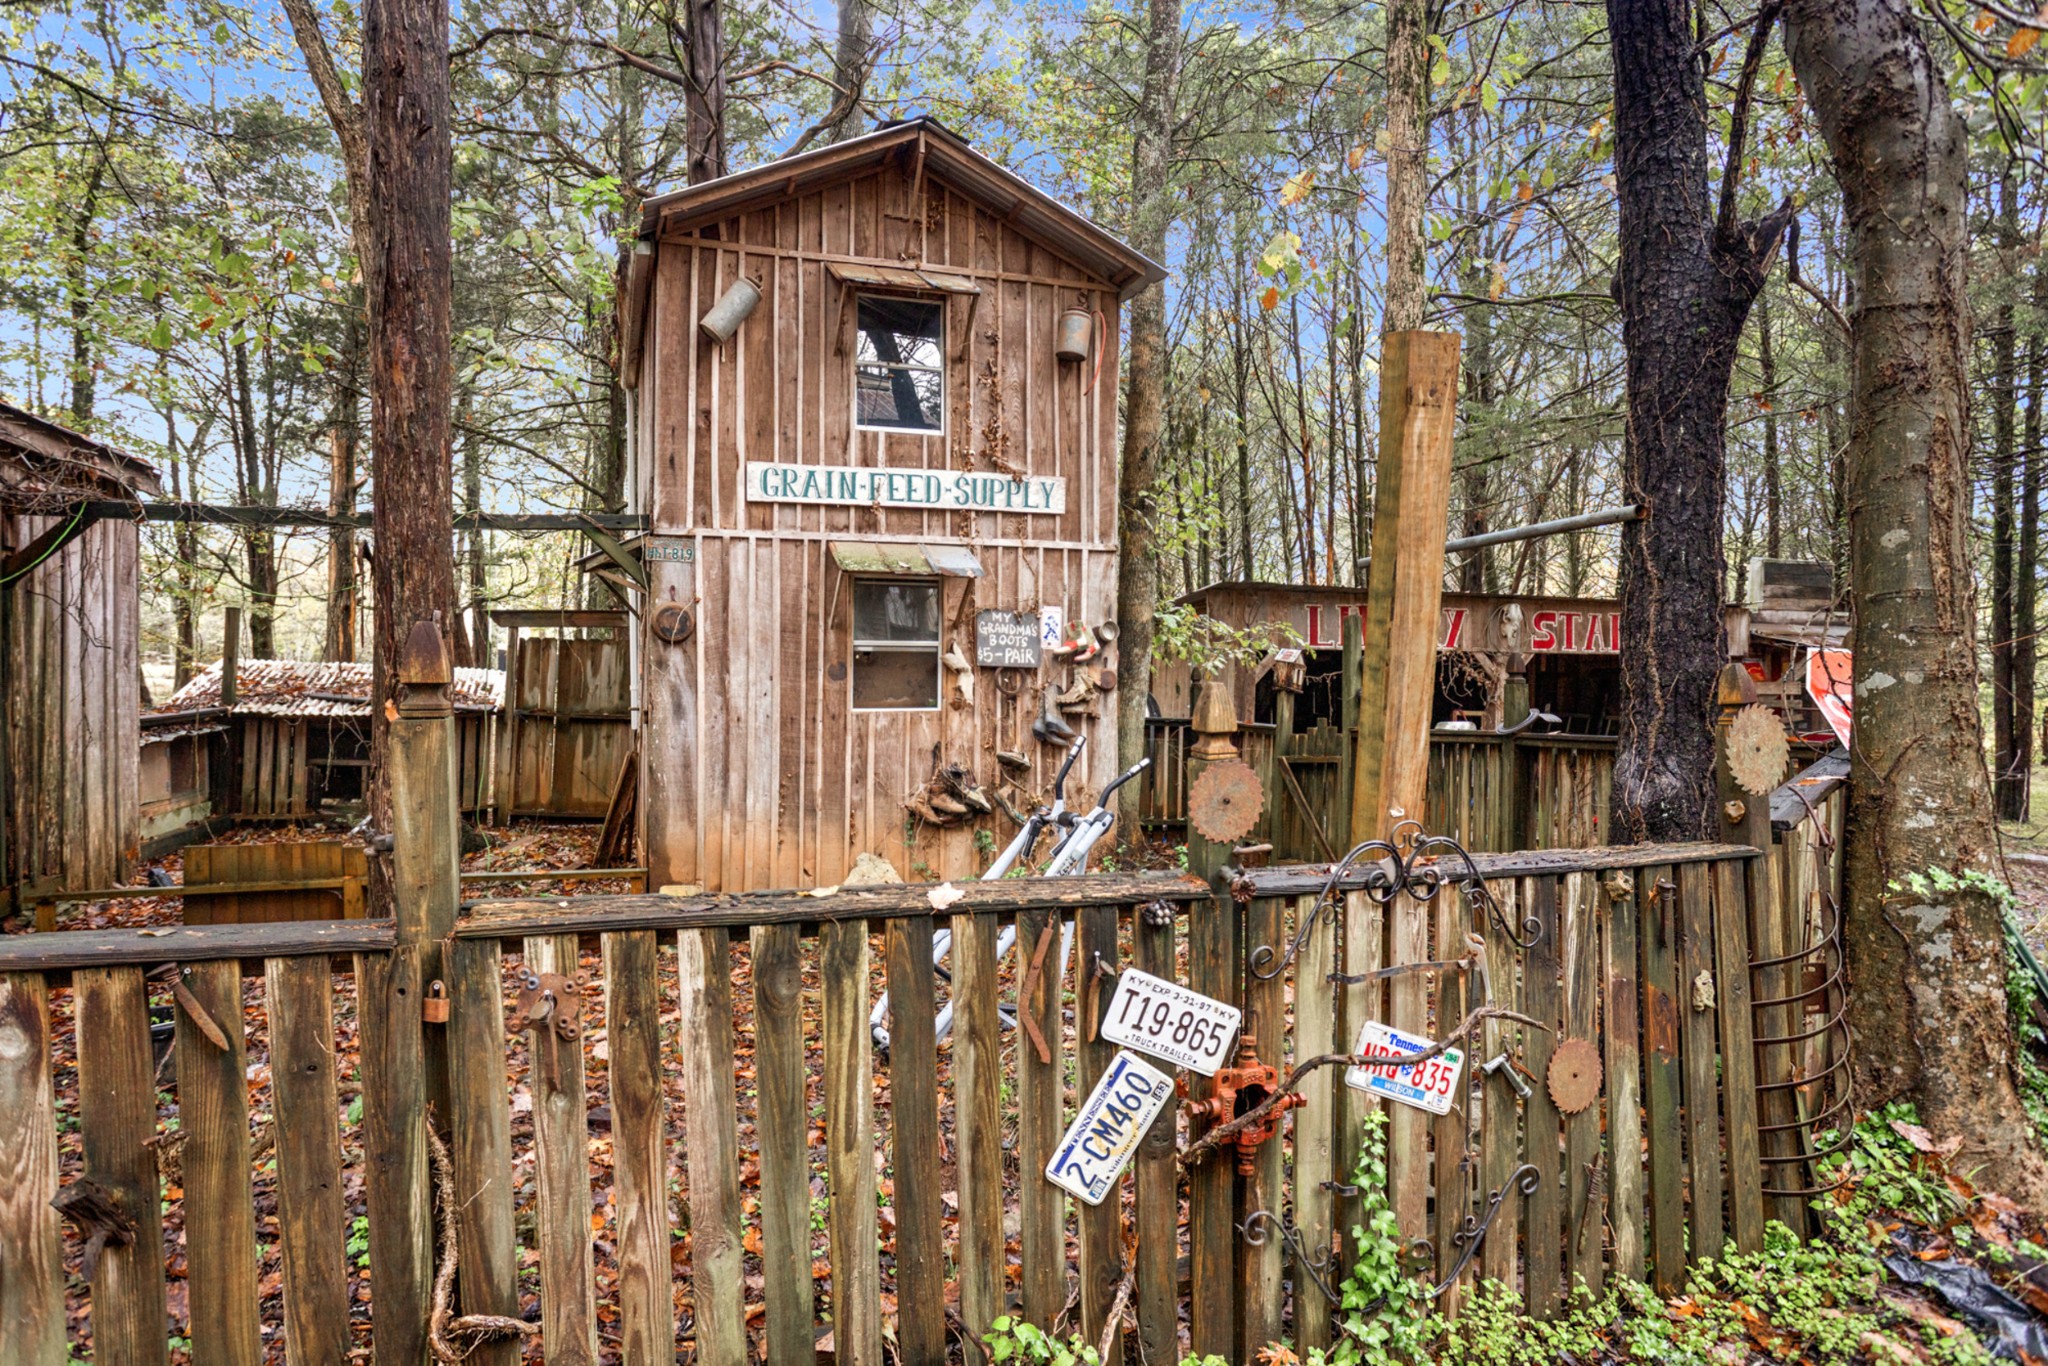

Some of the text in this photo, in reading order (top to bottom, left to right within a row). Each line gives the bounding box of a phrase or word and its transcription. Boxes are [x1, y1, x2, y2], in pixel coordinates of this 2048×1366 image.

[979, 621, 1038, 637] GRANDMA'S
[991, 611, 1012, 622] MY
[988, 634, 1029, 648] BOOTS
[1128, 975, 1145, 987] KY
[1219, 1010, 1236, 1021] KY
[1118, 987, 1227, 1058] T19-865
[1130, 1034, 1193, 1064] TRUCK TRAILER
[1384, 1082, 1415, 1097] WILSON
[1411, 1060, 1453, 1096] 835
[1066, 1071, 1152, 1189] 2-CM460
[1068, 1085, 1112, 1149] TENNESSEE
